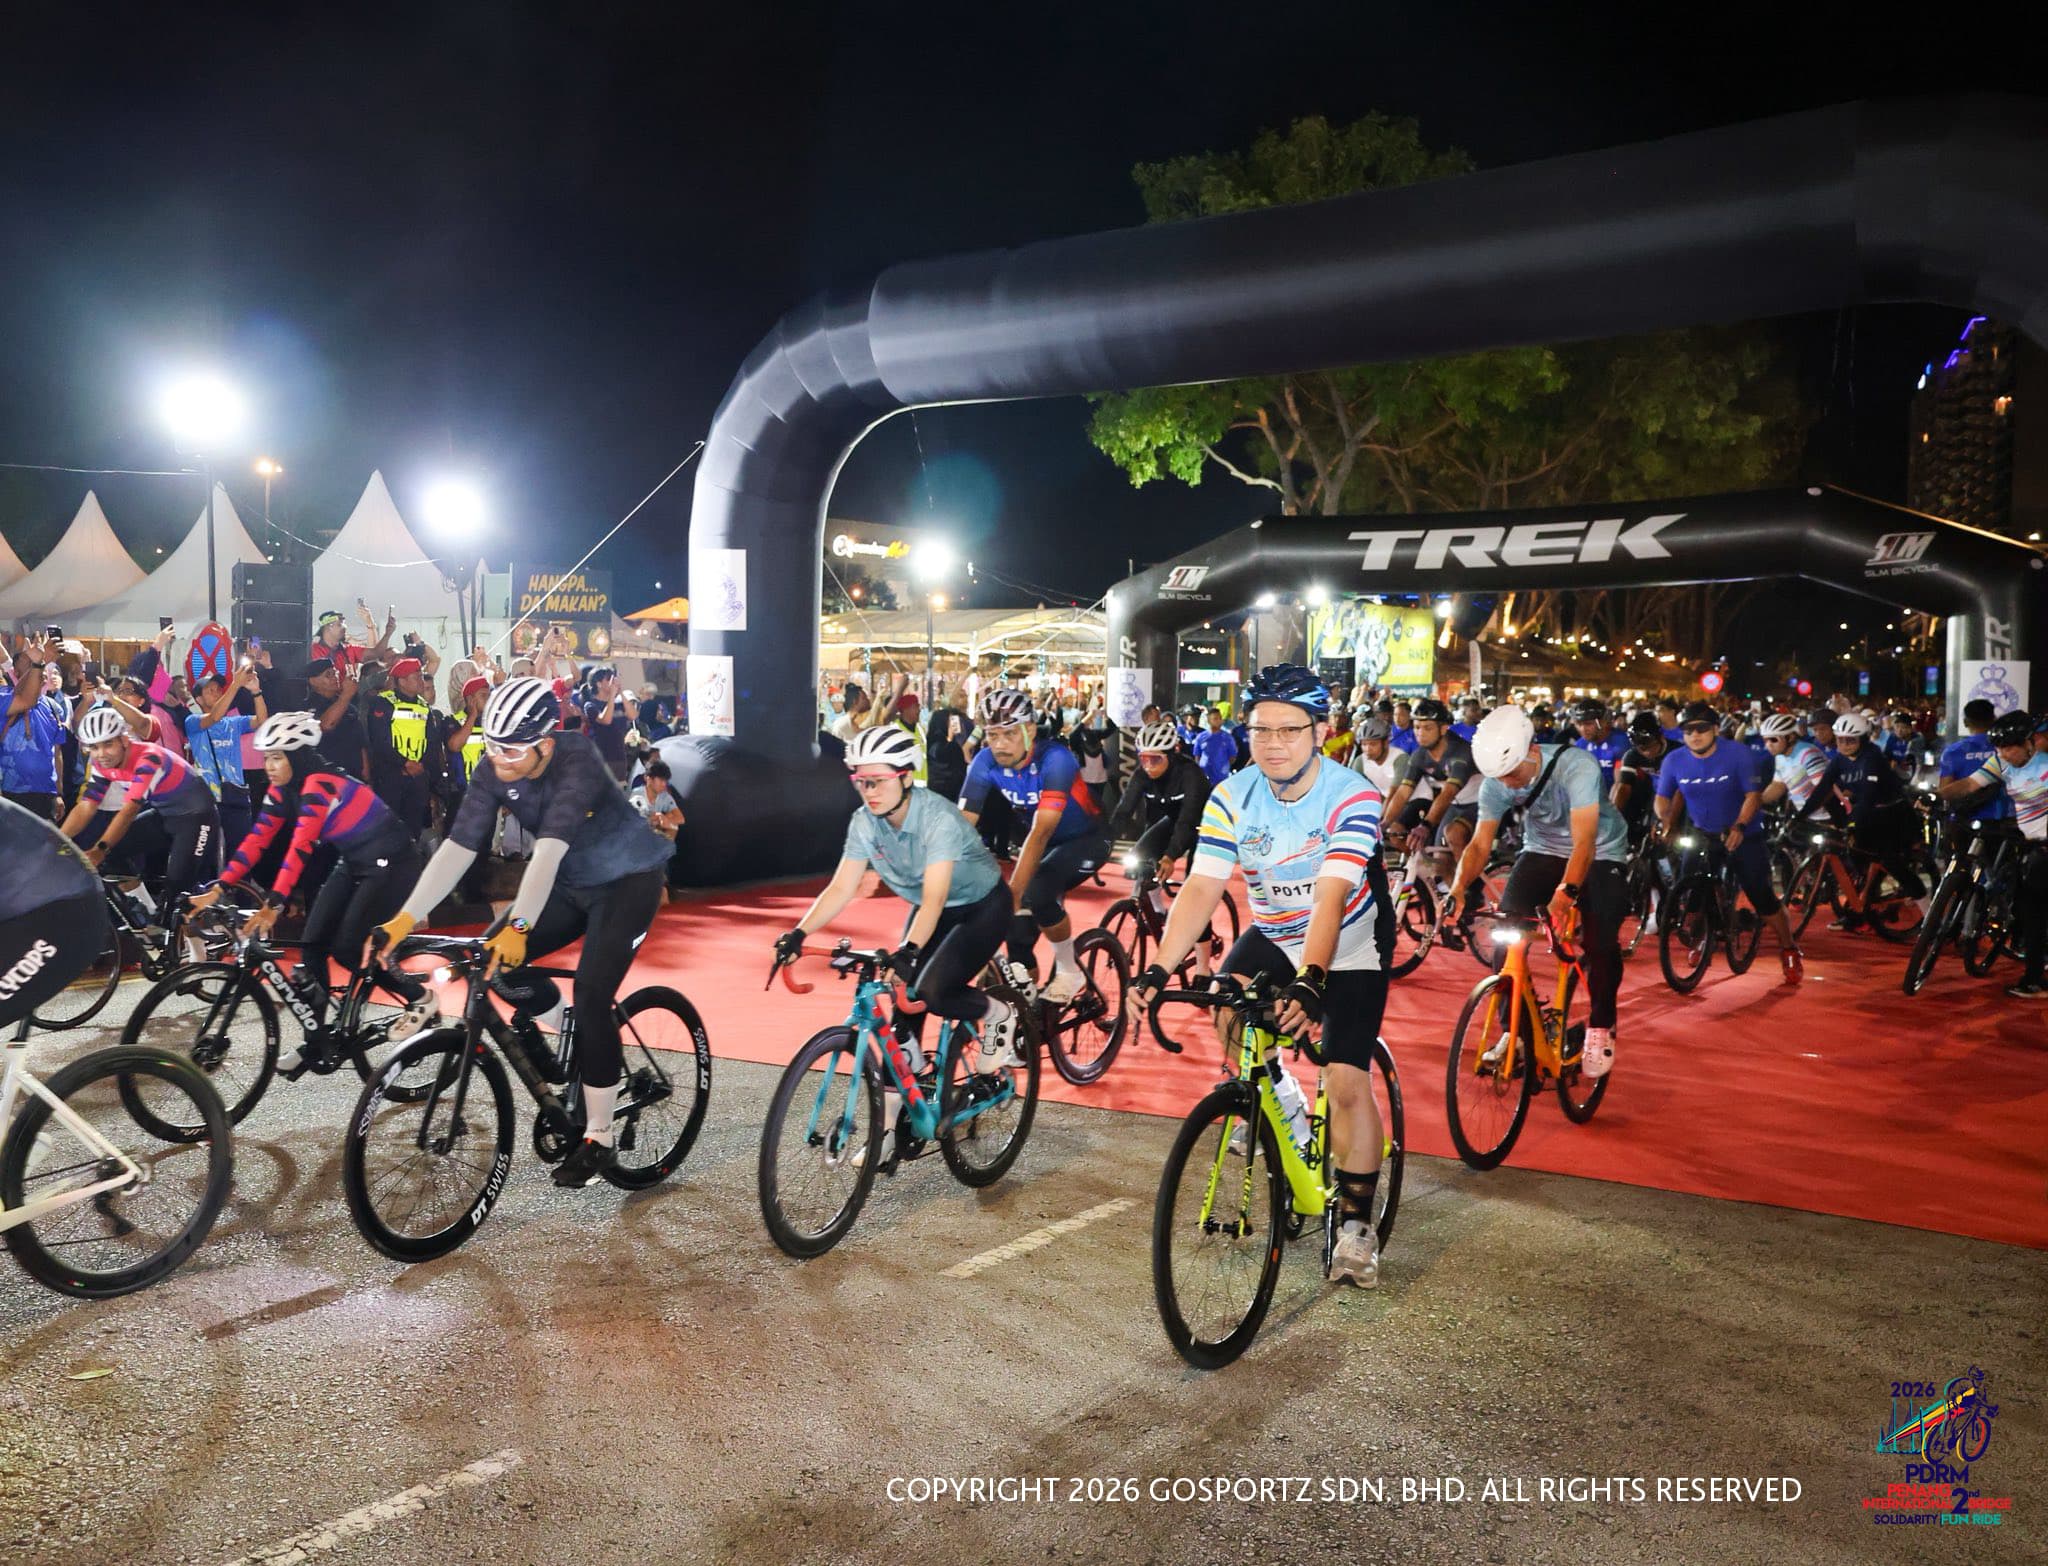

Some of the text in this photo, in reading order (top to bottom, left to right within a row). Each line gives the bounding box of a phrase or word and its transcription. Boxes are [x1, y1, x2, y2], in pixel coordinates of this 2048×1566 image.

[1347, 513, 1688, 571] TREK
[1864, 563, 1940, 577] SLM BICYCLE
[545, 594, 607, 612] MAKAN?
[1272, 882, 1317, 897] P017
[262, 961, 318, 1031] cervélo
[694, 1027, 709, 1065] SWISS
[471, 1152, 510, 1226] DT SWISS
